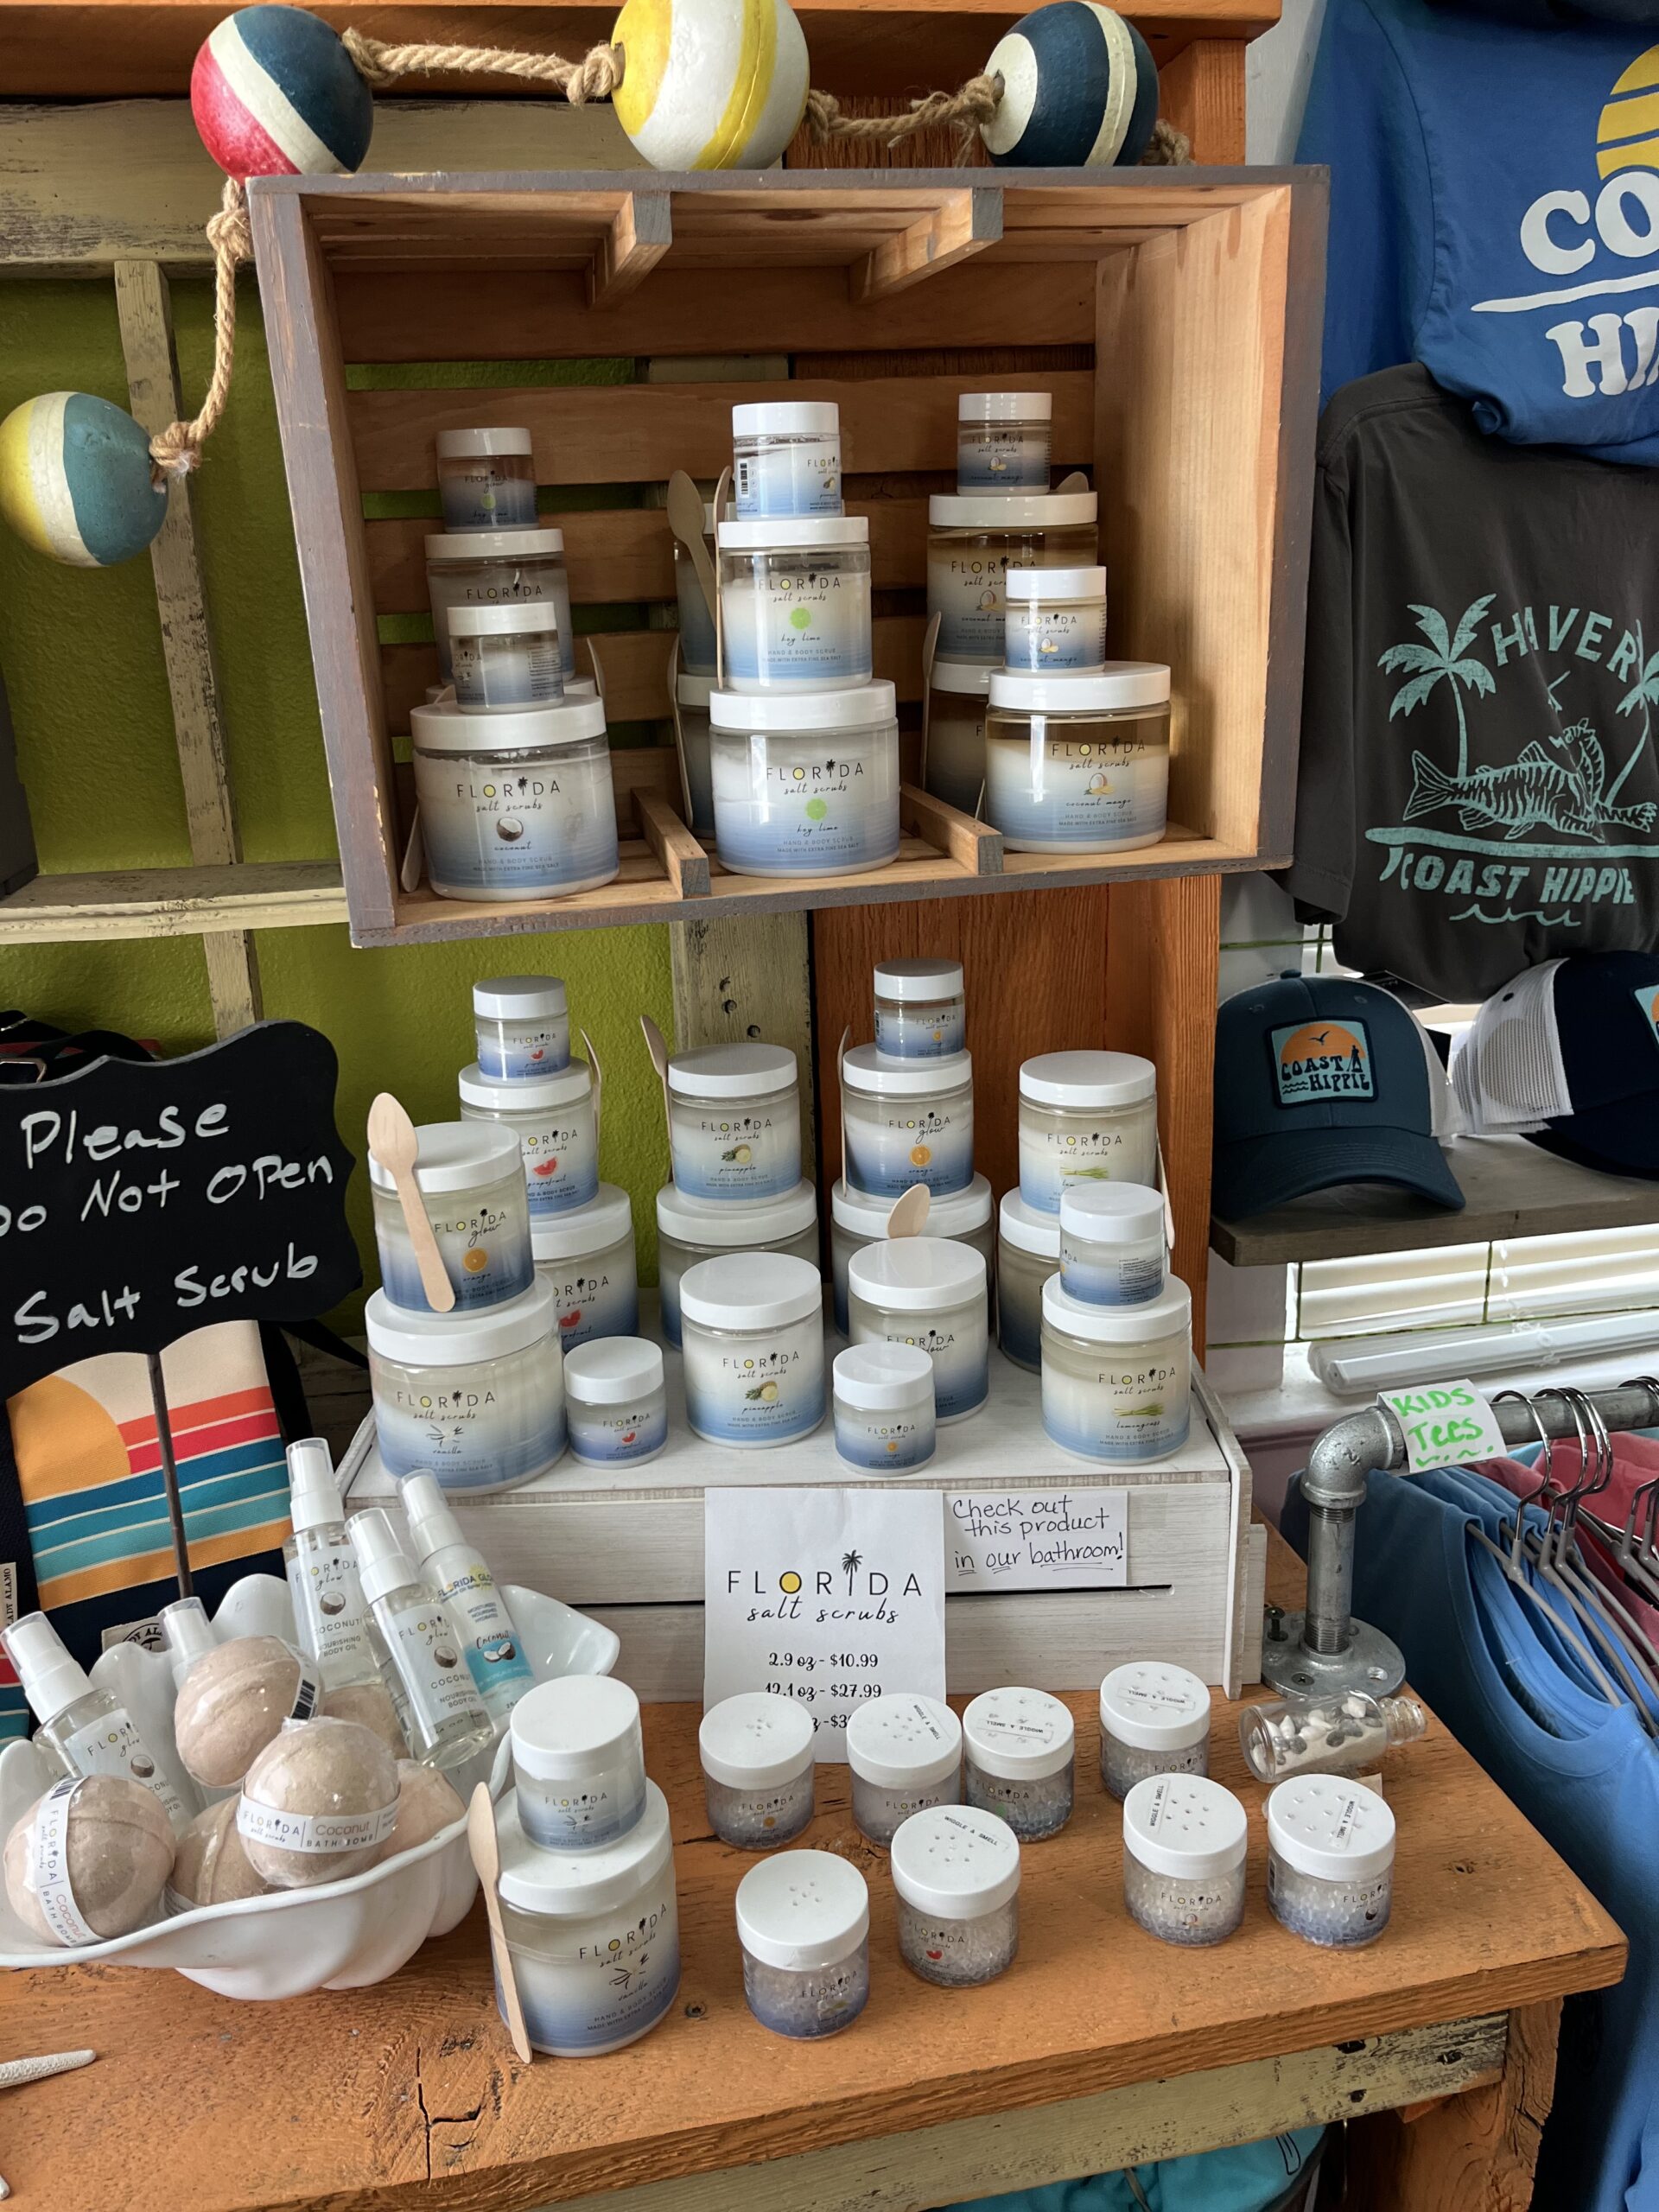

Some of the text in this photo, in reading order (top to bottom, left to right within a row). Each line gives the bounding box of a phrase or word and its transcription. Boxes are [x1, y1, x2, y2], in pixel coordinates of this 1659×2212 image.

[467, 582, 543, 600] FLORIDA
[759, 572, 841, 591] FLORIDA
[963, 575, 983, 587] salt
[773, 591, 827, 602] salt scrubs
[1052, 735, 1145, 757] FLORIDA
[766, 759, 863, 781] FLORIDA
[1069, 758, 1130, 770] salt scrubs
[457, 777, 561, 798] FLORIDA
[784, 780, 848, 795] salt scrubs
[476, 798, 543, 813] salt scrubs
[797, 823, 838, 836] key lime
[1281, 1055, 1343, 1082] COAST
[1308, 1073, 1370, 1092] HIPPIE
[702, 1117, 772, 1132] FLORIDA
[888, 1111, 950, 1129] FLORIDA
[21, 1103, 230, 1170] Please
[916, 1123, 944, 1143] glow
[1048, 1132, 1122, 1147] FLORIDA
[1059, 1147, 1108, 1156] salt scrubs
[81, 1170, 181, 1222] Not
[435, 1208, 506, 1234] FLORIDA
[468, 1223, 502, 1249] glow
[14, 1242, 319, 1344] Salt Scrub
[723, 1351, 799, 1370] FLORIDA
[737, 1367, 787, 1379] salt scrubs
[1099, 1366, 1176, 1385] FLORIDA
[397, 1389, 495, 1408] FLORIDA
[1114, 1383, 1164, 1395] salt scrubs
[1391, 1387, 1475, 1417] KIDS
[413, 1408, 477, 1421] salt scrubs
[868, 1424, 915, 1434] FLORIDA
[953, 1495, 1072, 1518] Check out
[964, 1507, 1109, 1540] this product
[955, 1531, 1123, 1568] in our bathroom!
[315, 1565, 343, 1592] glow
[728, 1549, 923, 1597] FLORIDA
[3, 1567, 12, 1600] ALAMO
[747, 1595, 899, 1624] salt scrubs
[768, 1652, 879, 1672] 2.9 oz $10.99
[765, 1682, 882, 1702] 12.1 oz $27.99
[545, 1792, 607, 1807] FLORIDA
[886, 1796, 940, 1809] FLORIDA
[1149, 1807, 1160, 1827] WIGGLE
[1155, 1785, 1165, 1801] SMELL
[243, 1810, 300, 1836] FLORIDA
[315, 1821, 370, 1836] Coconut
[944, 1815, 969, 1830] WIGGLE
[978, 1833, 999, 1847] SMELL
[48, 1809, 60, 1881] FLORIDA
[306, 1838, 338, 1847] BATH
[42, 1891, 58, 1919] BATH
[1160, 1891, 1222, 1906] FLORIDA
[55, 1893, 87, 1939] Coconut
[579, 1904, 667, 1960] FLORIDA
[600, 1931, 656, 1968] salt scrubs
